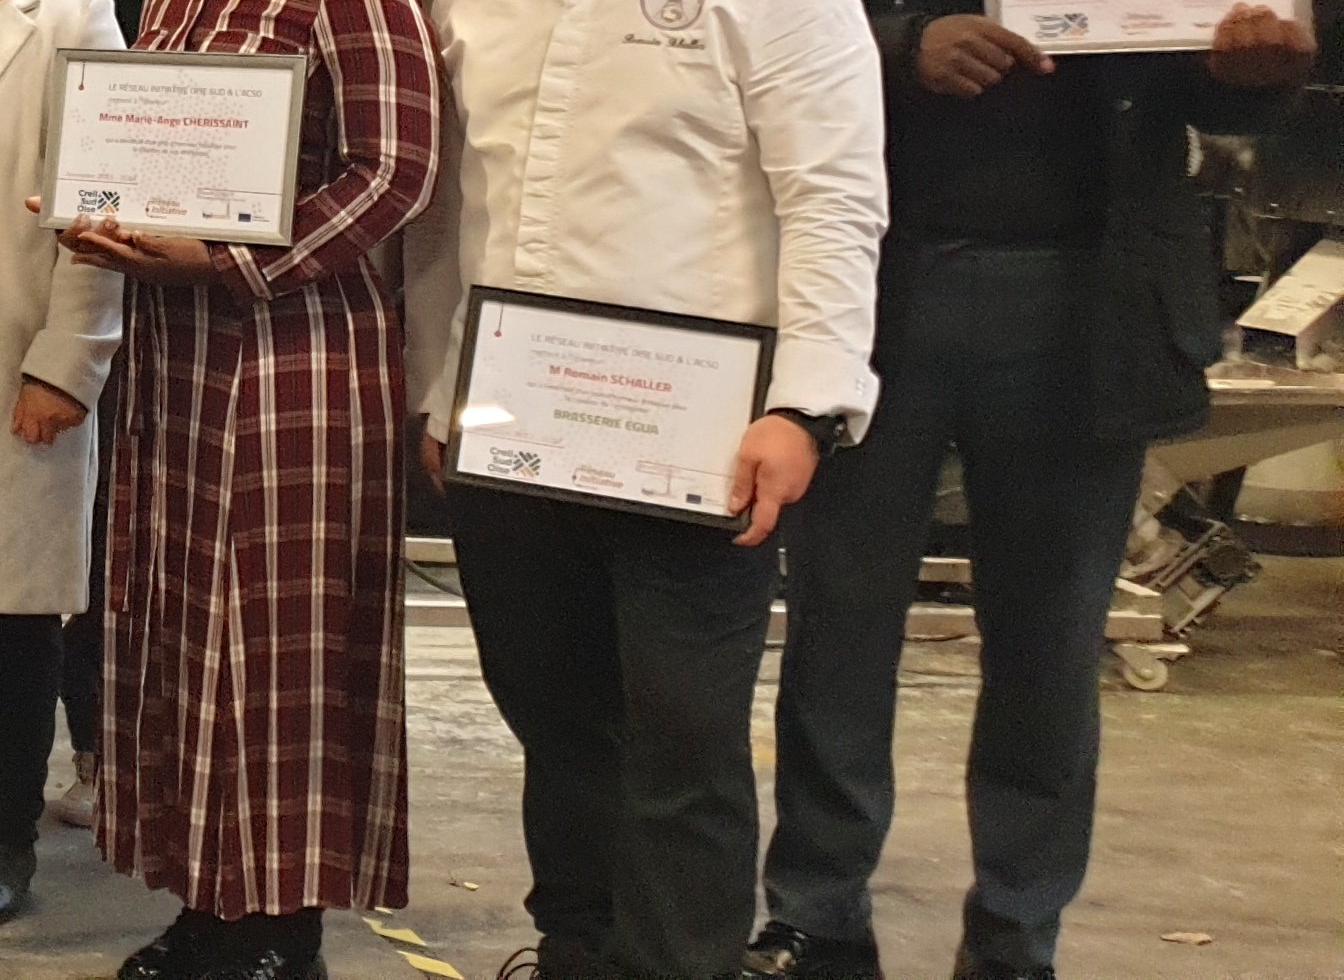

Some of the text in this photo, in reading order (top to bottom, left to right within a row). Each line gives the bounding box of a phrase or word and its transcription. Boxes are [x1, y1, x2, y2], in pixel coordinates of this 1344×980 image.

[99, 112, 249, 129] Mme Marie-Ange CHERISSAINT
[77, 205, 96, 213] Oise
[564, 367, 608, 382] Romain
[610, 374, 672, 393] SCHALLER
[553, 409, 622, 430] BRASSERIE
